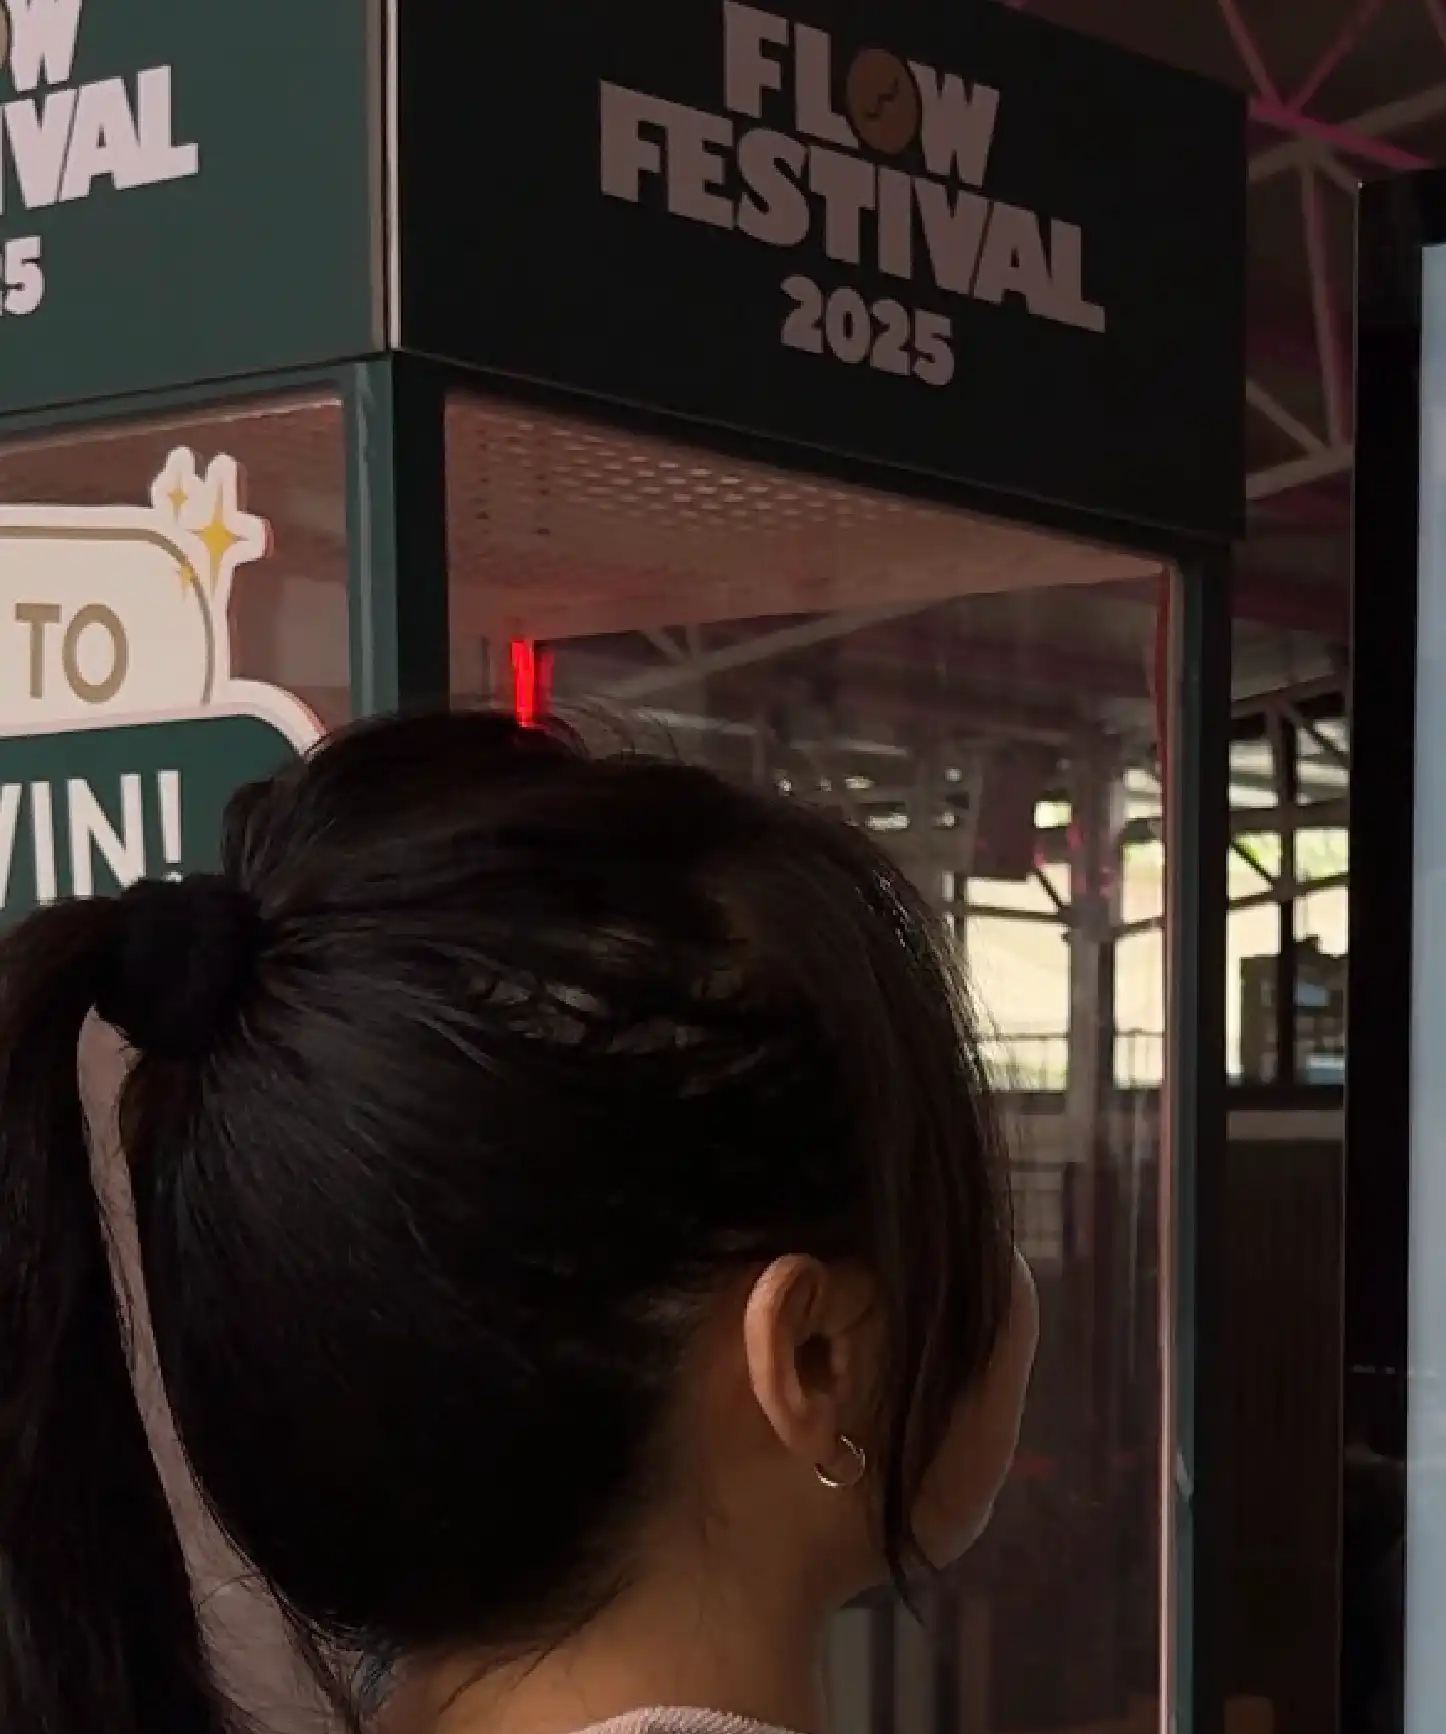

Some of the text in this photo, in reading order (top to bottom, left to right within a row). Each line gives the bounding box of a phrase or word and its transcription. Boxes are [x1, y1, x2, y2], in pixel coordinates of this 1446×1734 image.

[0, 64, 200, 216] VAL
[724, 0, 1000, 188] FLOW
[0, 235, 45, 317] 5
[600, 79, 1106, 334] FESTIVAL
[781, 275, 955, 387] 2025
[15, 602, 129, 703] TO
[0, 769, 184, 908] IN!
